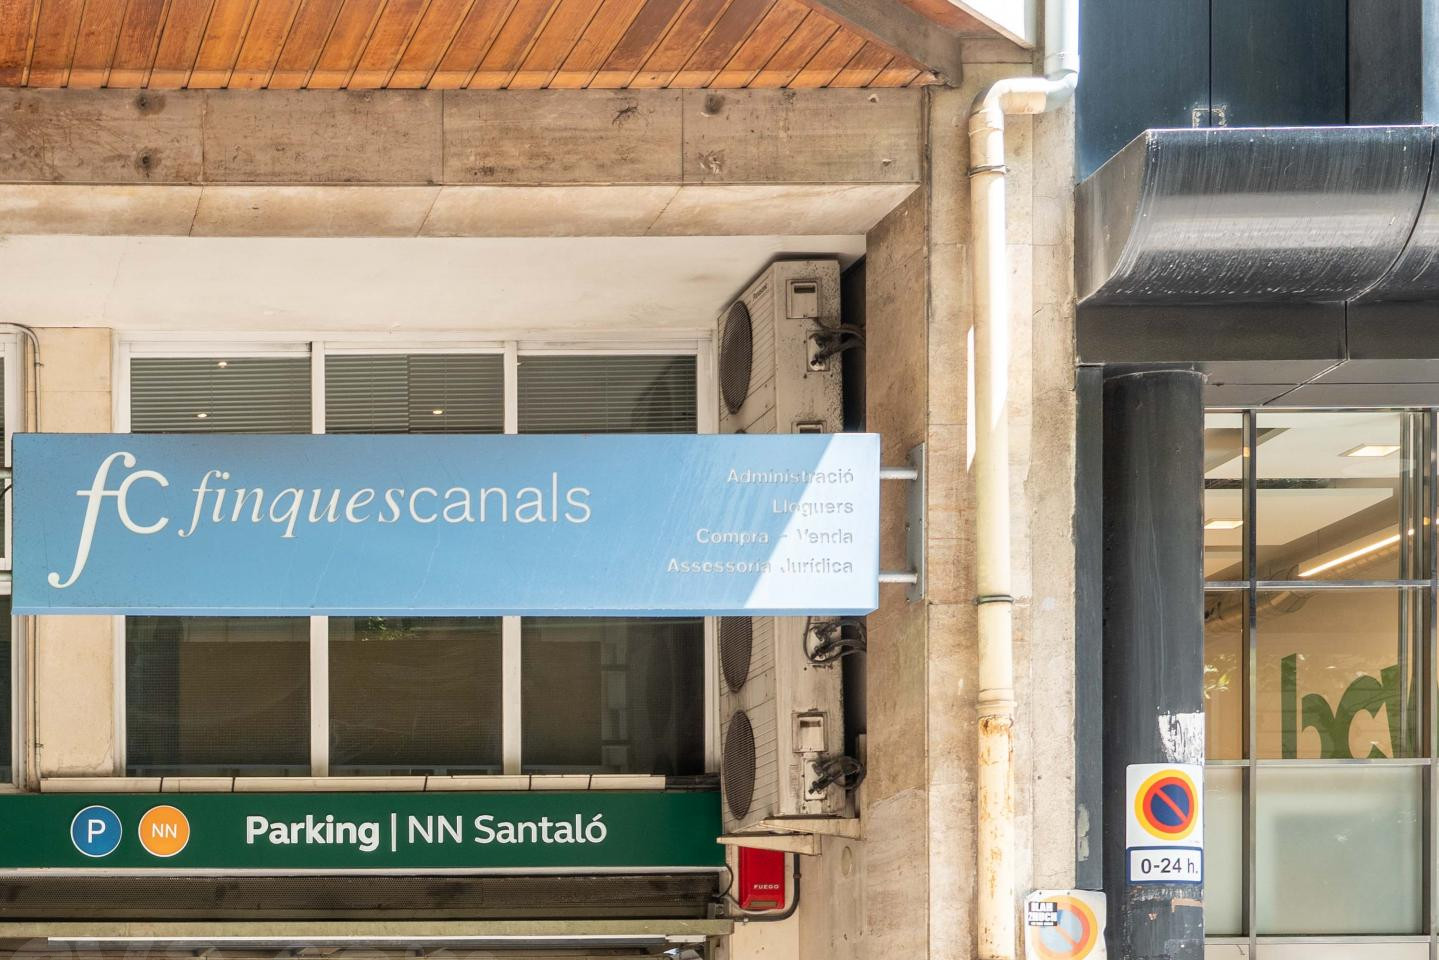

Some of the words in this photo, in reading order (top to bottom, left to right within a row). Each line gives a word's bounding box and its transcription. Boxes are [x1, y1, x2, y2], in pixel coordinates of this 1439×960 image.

[727, 468, 854, 484] Administració
[772, 499, 854, 517] Lloguers
[696, 528, 769, 546] Compra
[796, 528, 853, 544] Venda
[667, 558, 771, 573] Assessoria
[780, 557, 853, 574] Jurídica
[86, 819, 107, 843] P
[151, 823, 178, 839] NN
[245, 814, 380, 852] Parking
[408, 816, 462, 844] NN
[474, 813, 607, 845] Santaló
[1141, 858, 1182, 874] 0-24
[746, 883, 768, 891] FUEGO
